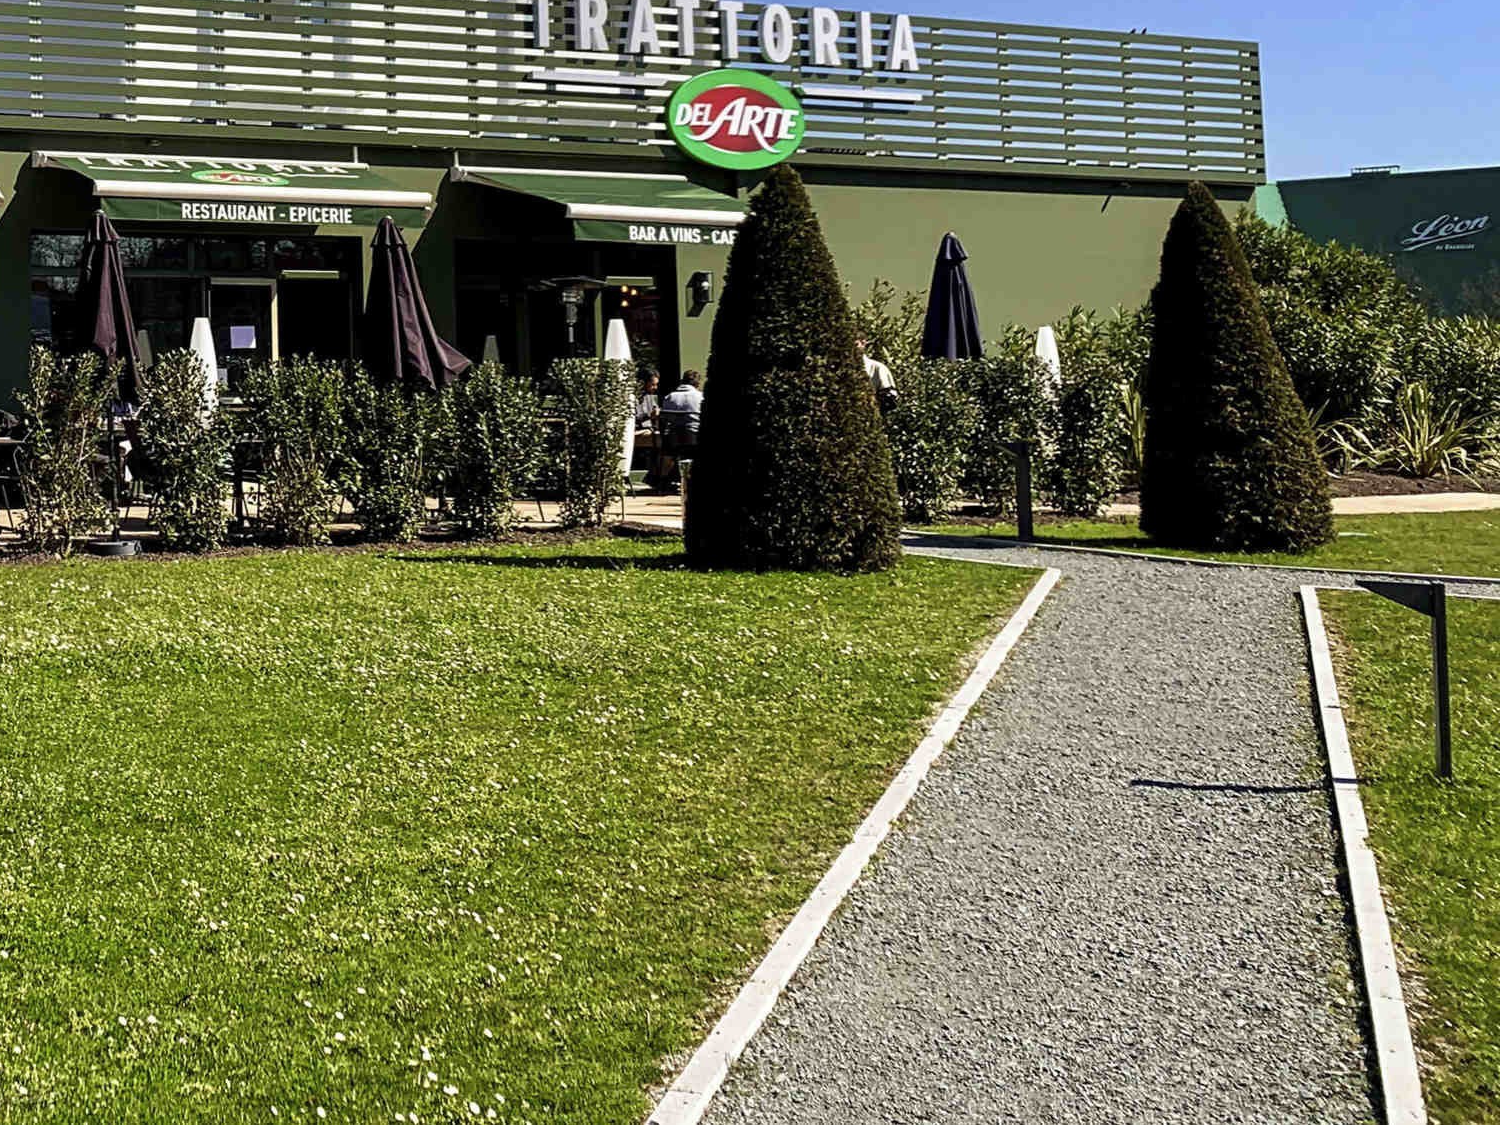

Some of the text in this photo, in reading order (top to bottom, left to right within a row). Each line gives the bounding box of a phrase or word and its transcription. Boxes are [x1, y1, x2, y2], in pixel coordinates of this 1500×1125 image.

[181, 202, 276, 222] RESTAURANT
[289, 206, 353, 224] EPICERIE
[629, 225, 656, 241] BAR
[659, 227, 669, 242] A
[670, 227, 701, 243] VINS
[711, 230, 739, 245] CAF
